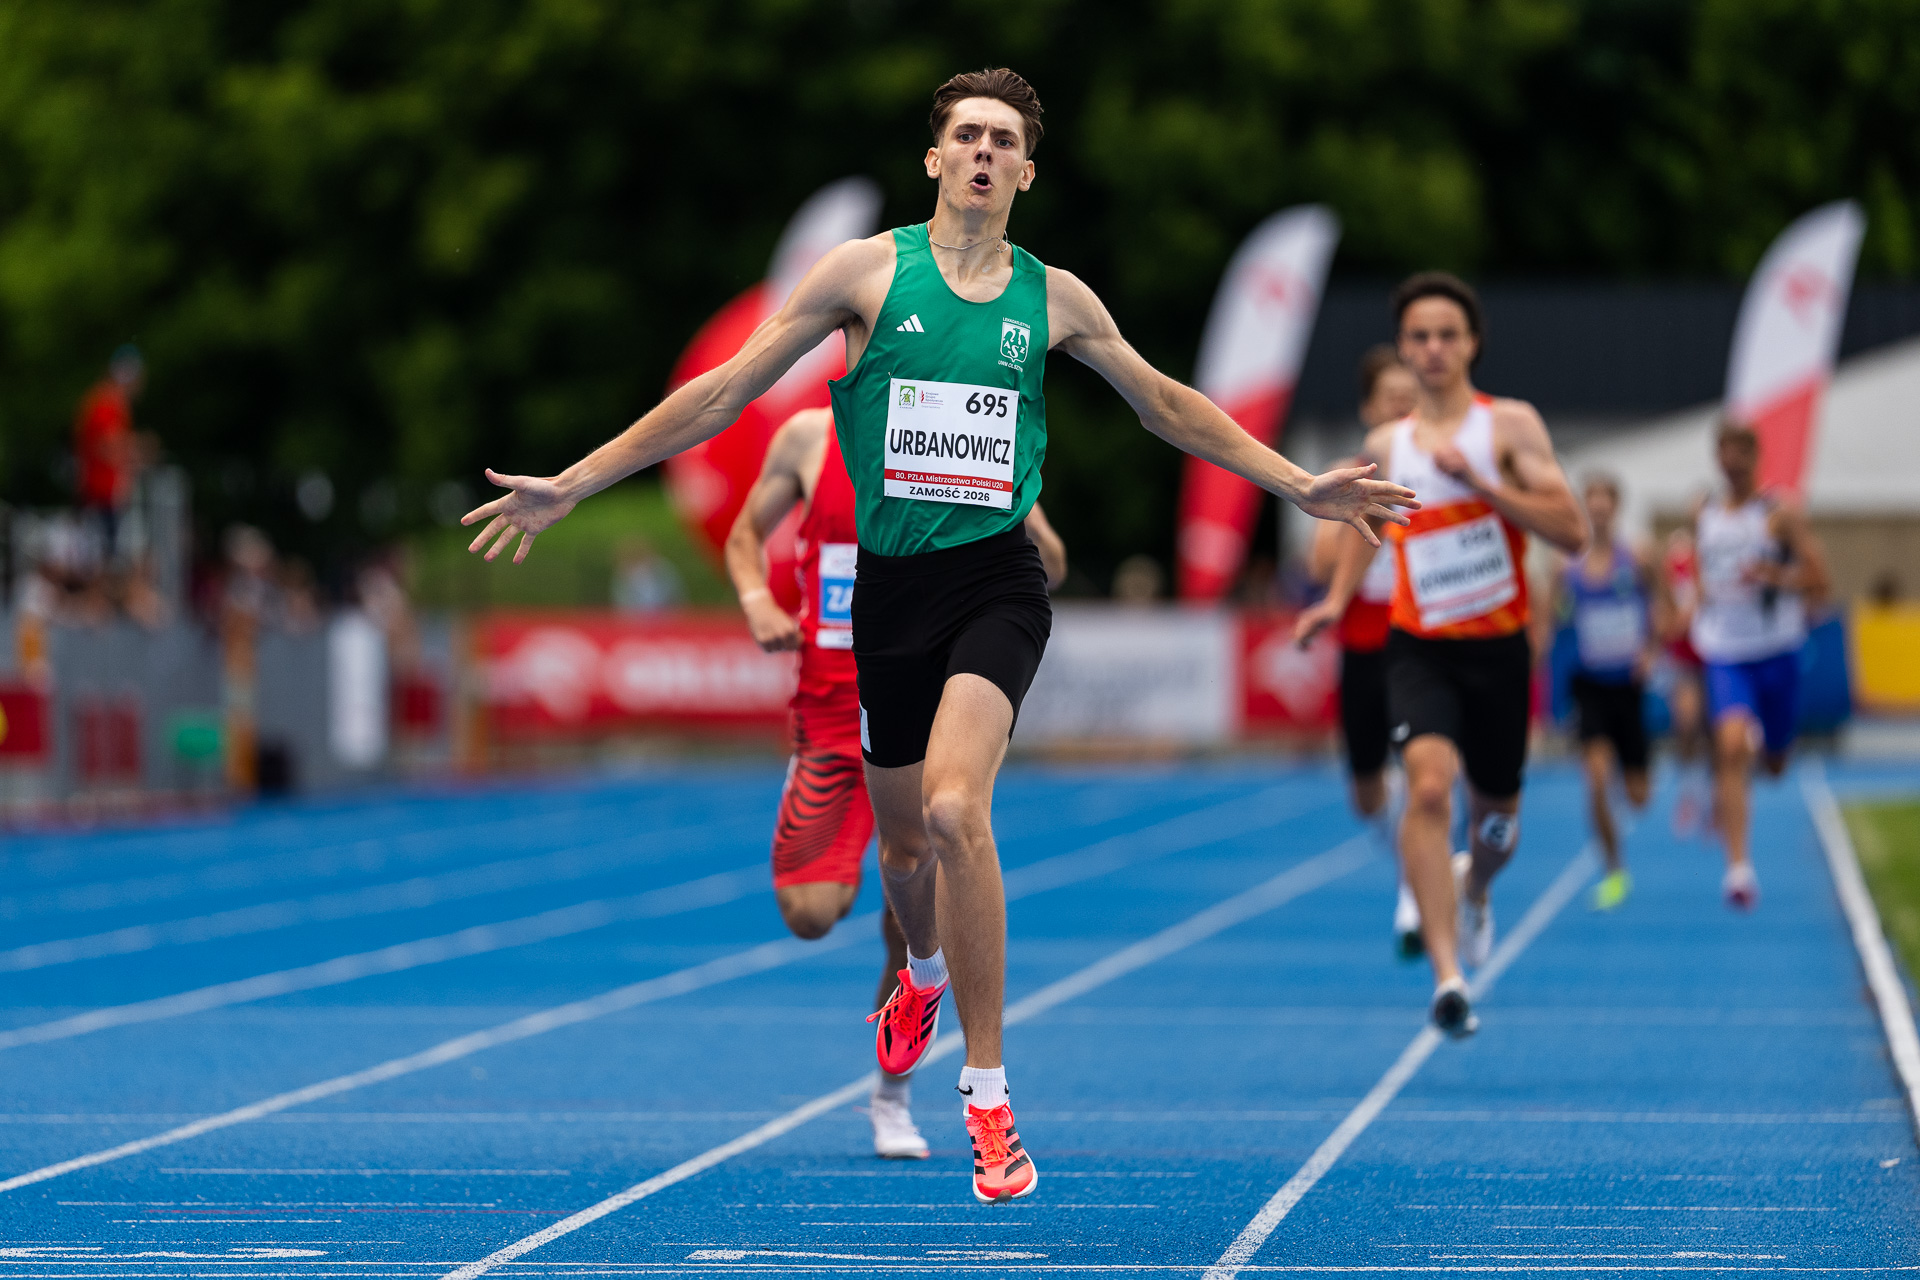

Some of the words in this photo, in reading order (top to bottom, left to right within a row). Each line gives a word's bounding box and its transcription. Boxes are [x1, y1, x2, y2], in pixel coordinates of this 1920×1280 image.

[965, 391, 1009, 418] 695
[889, 428, 1011, 466] URBANOWICZ
[895, 471, 907, 480] 80.
[907, 473, 925, 482] PZLA
[925, 475, 971, 486] Mistrzostwa
[971, 478, 992, 488] Polski
[991, 481, 1004, 490] U20
[909, 486, 961, 499] ZAMOŚĆ
[963, 490, 990, 502] 2026
